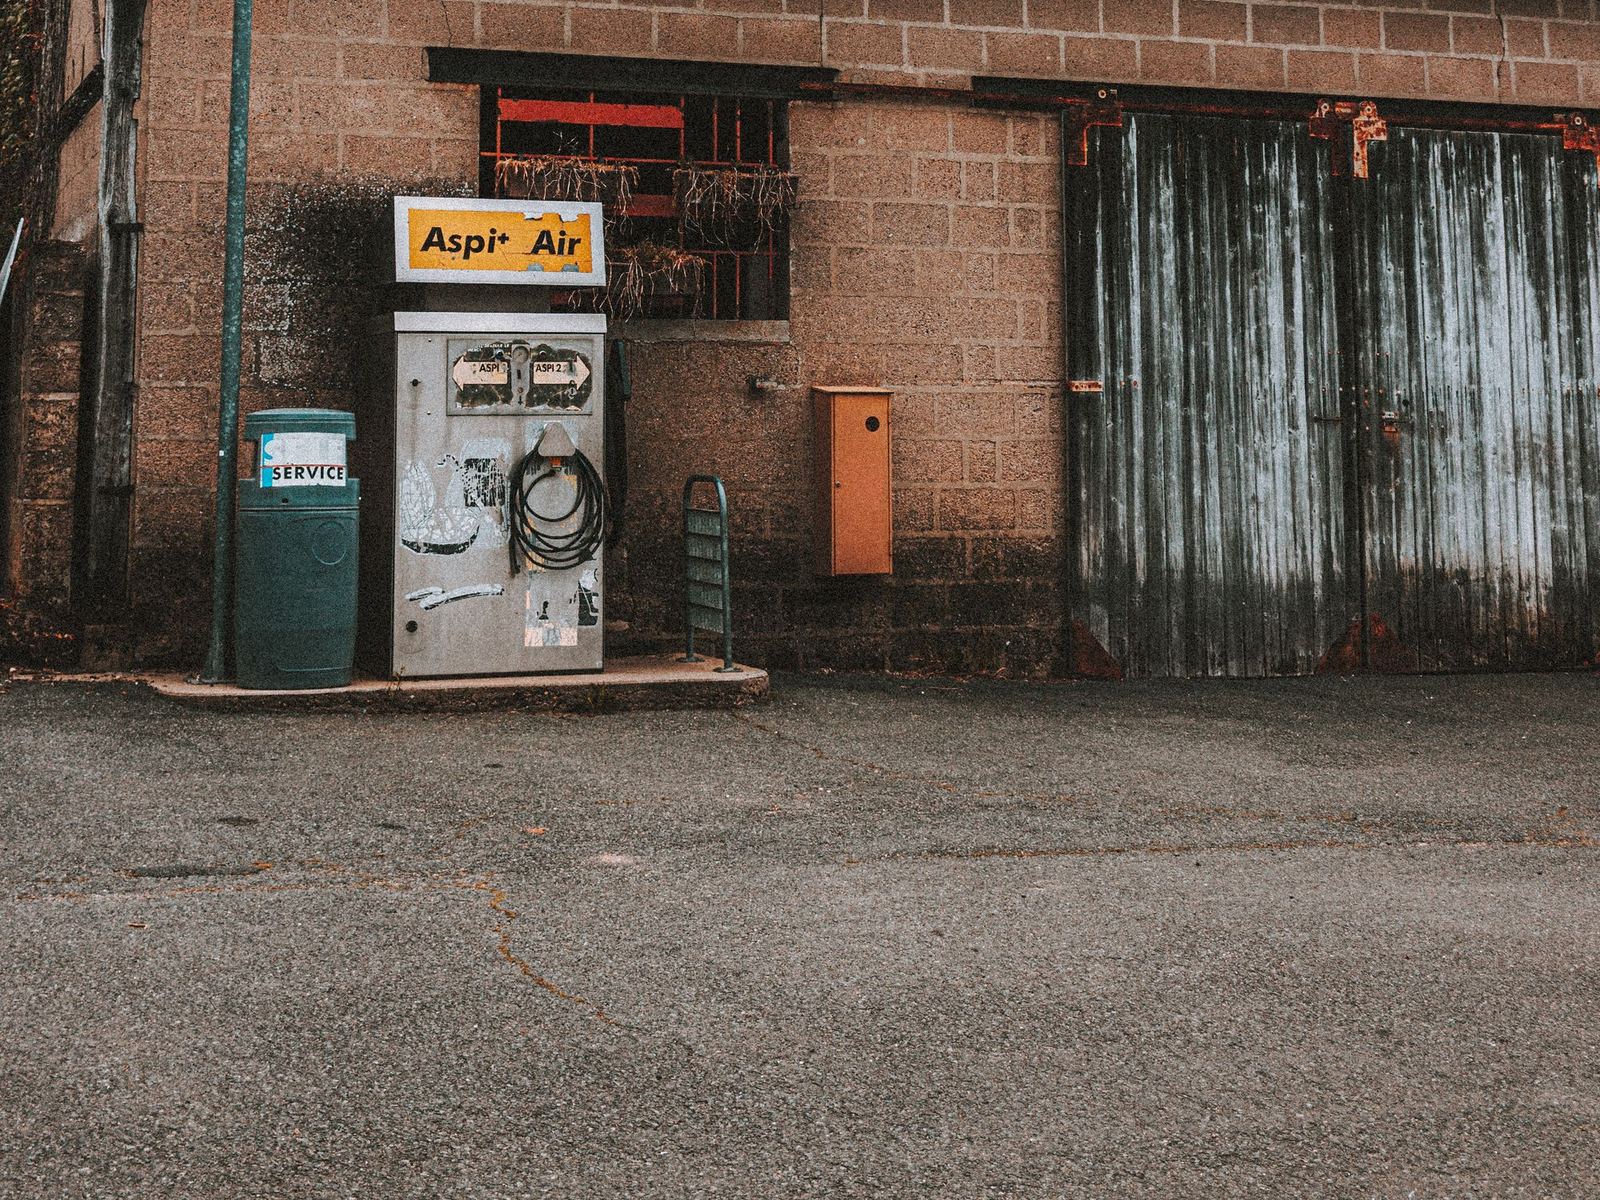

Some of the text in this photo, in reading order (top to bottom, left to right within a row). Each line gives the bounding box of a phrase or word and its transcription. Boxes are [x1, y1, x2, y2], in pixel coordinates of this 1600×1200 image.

[530, 229, 582, 256] Air
[479, 363, 500, 373] ASPI
[535, 363, 562, 373] ASPI 2
[272, 466, 344, 480] SERVICE
